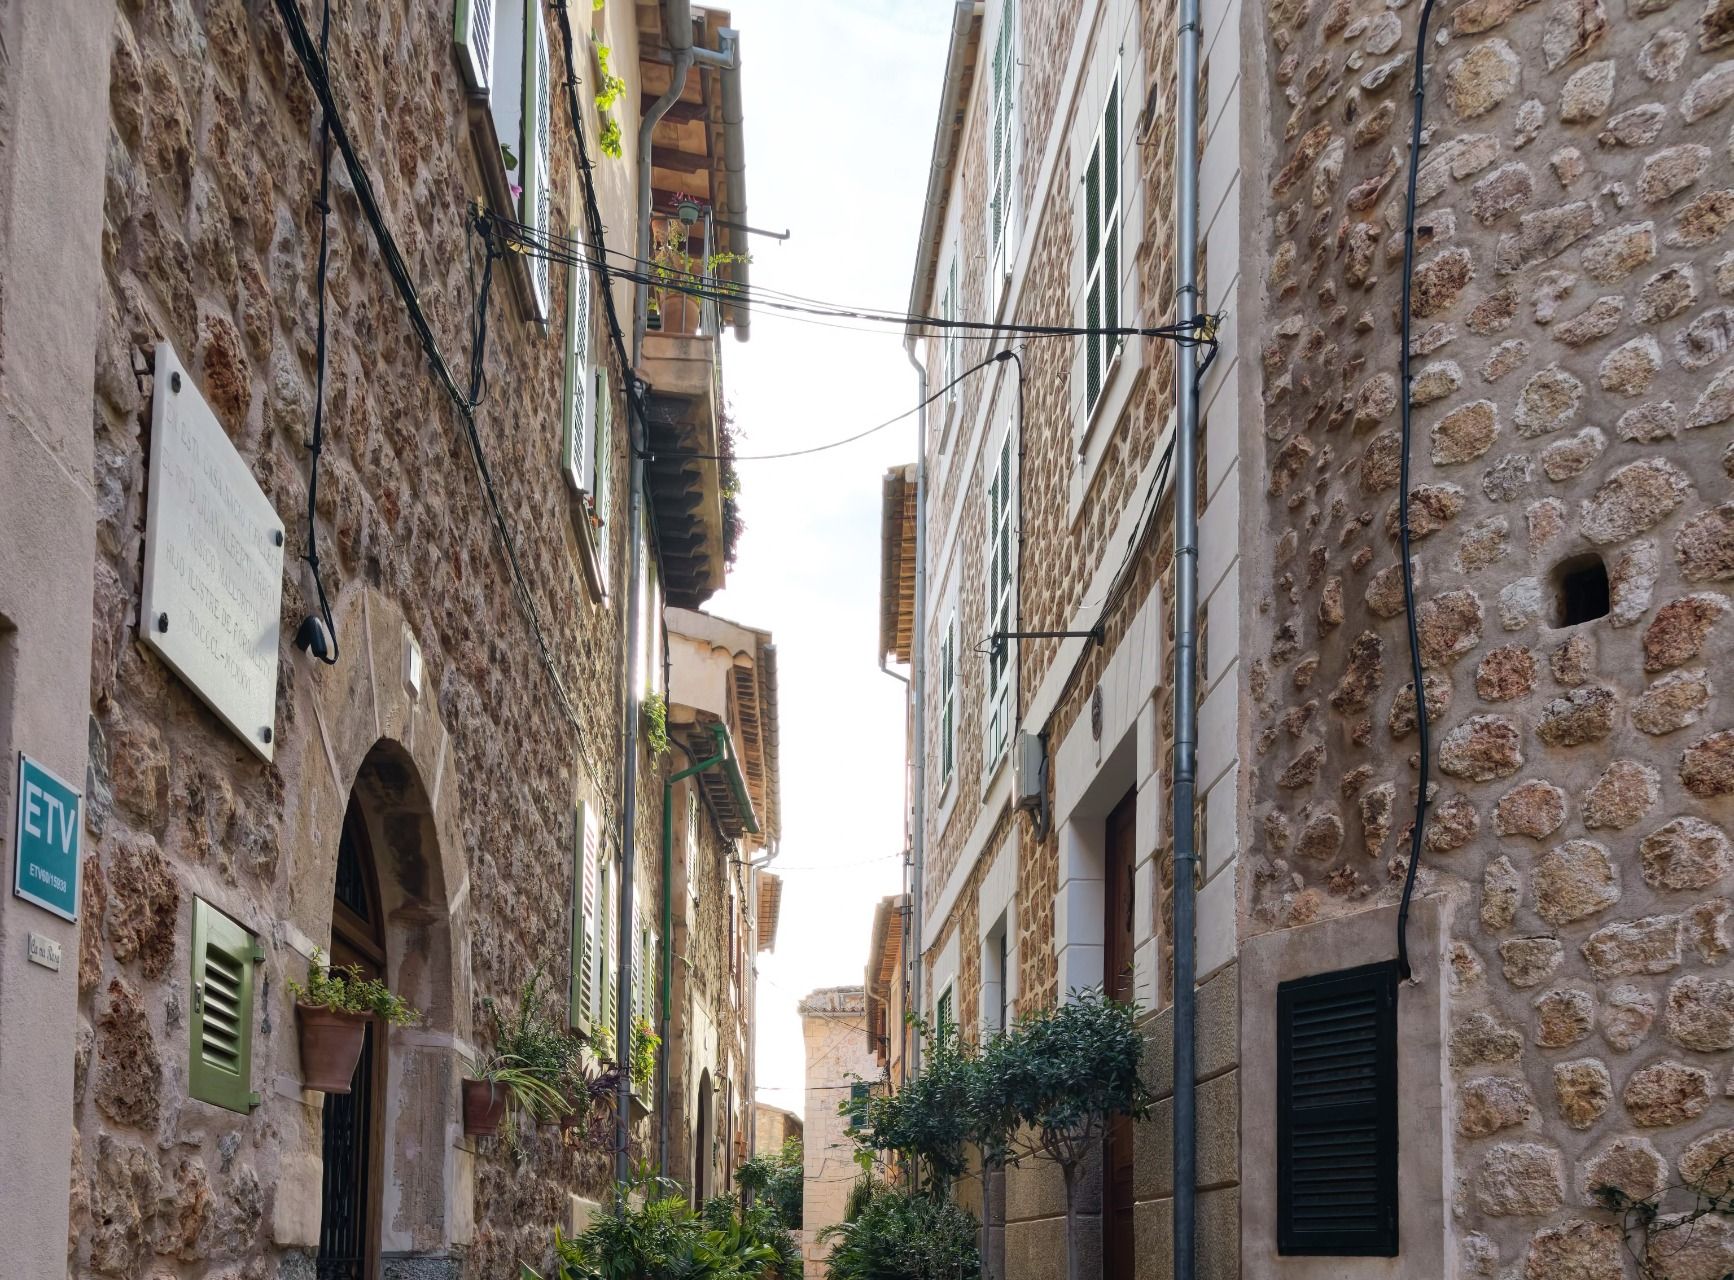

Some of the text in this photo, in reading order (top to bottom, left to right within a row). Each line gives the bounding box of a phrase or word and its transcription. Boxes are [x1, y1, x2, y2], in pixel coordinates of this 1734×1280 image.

[180, 421, 200, 463] ESTA
[202, 454, 222, 494] CASA
[186, 522, 216, 574] MUSICO
[197, 490, 220, 538] JUAN
[165, 541, 185, 577] HIJO
[186, 565, 221, 621] ILUSTRE
[220, 607, 232, 634] DE
[25, 780, 76, 855] ETV
